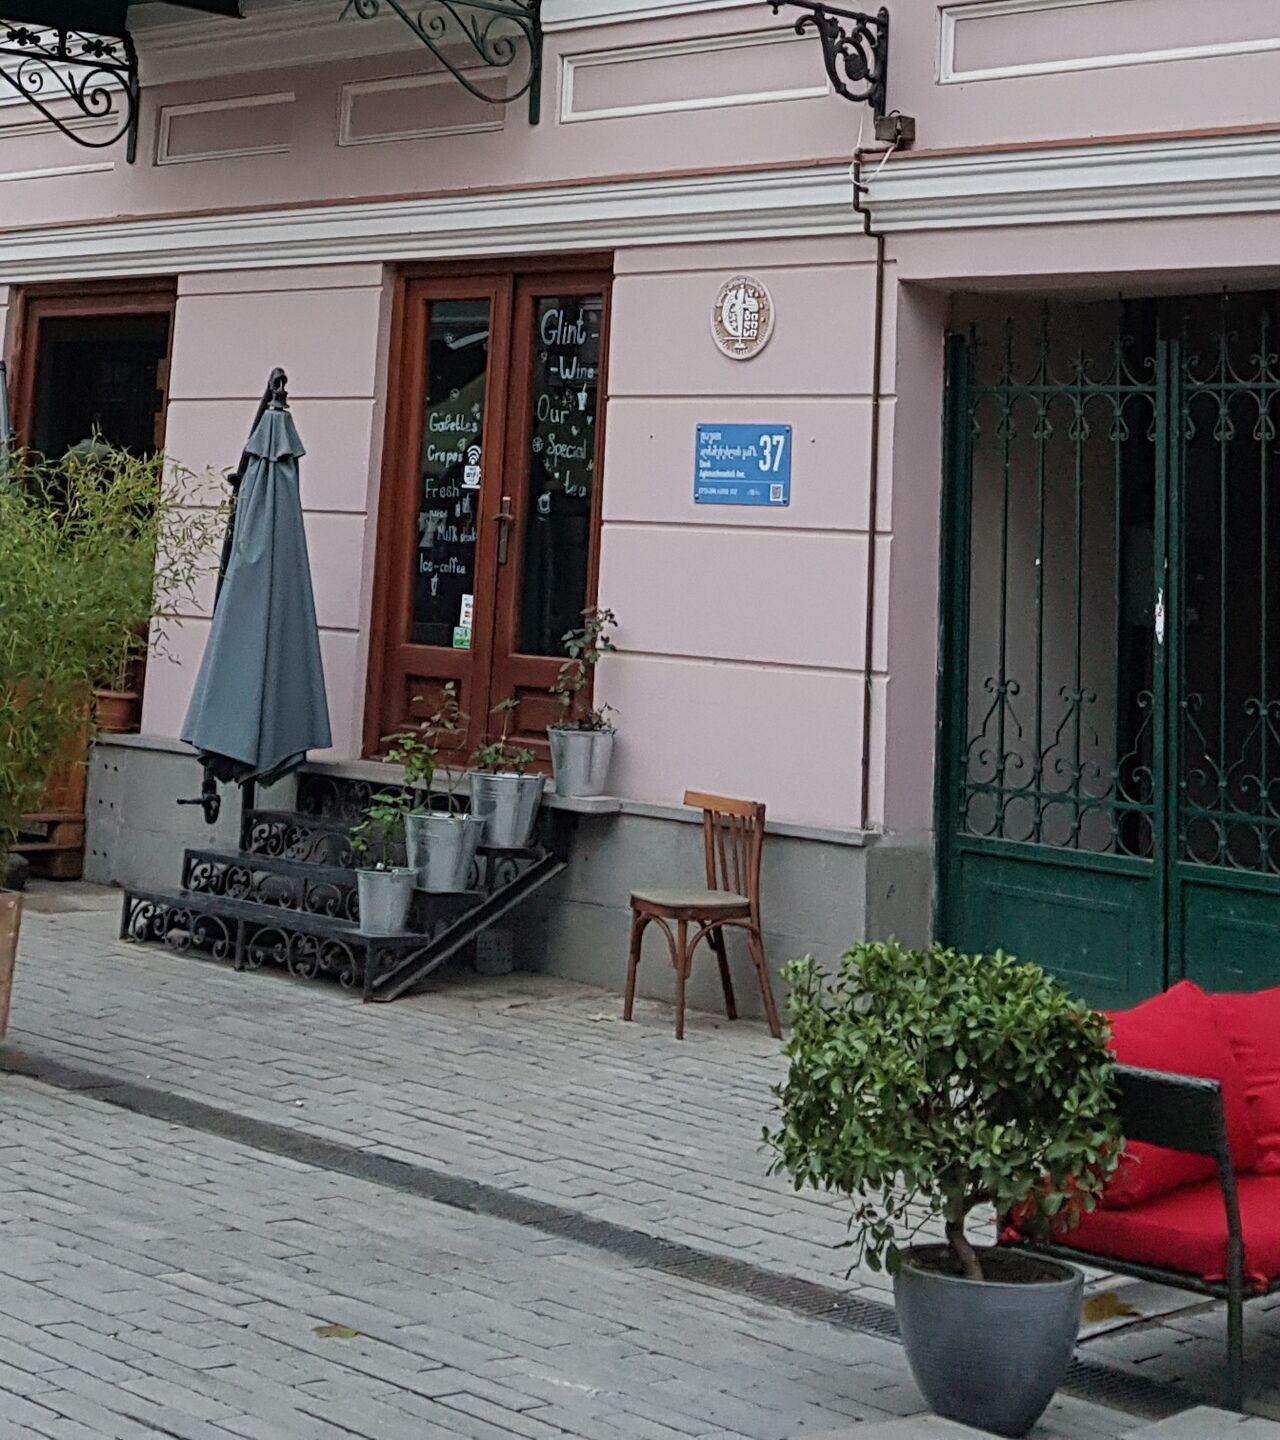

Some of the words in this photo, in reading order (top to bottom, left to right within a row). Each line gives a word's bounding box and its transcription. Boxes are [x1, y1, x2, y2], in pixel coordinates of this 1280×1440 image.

[537, 394, 570, 424] Our
[546, 433, 587, 467] Special
[759, 434, 785, 472] 37
[425, 478, 460, 499] Fresh
[563, 470, 587, 497] tea
